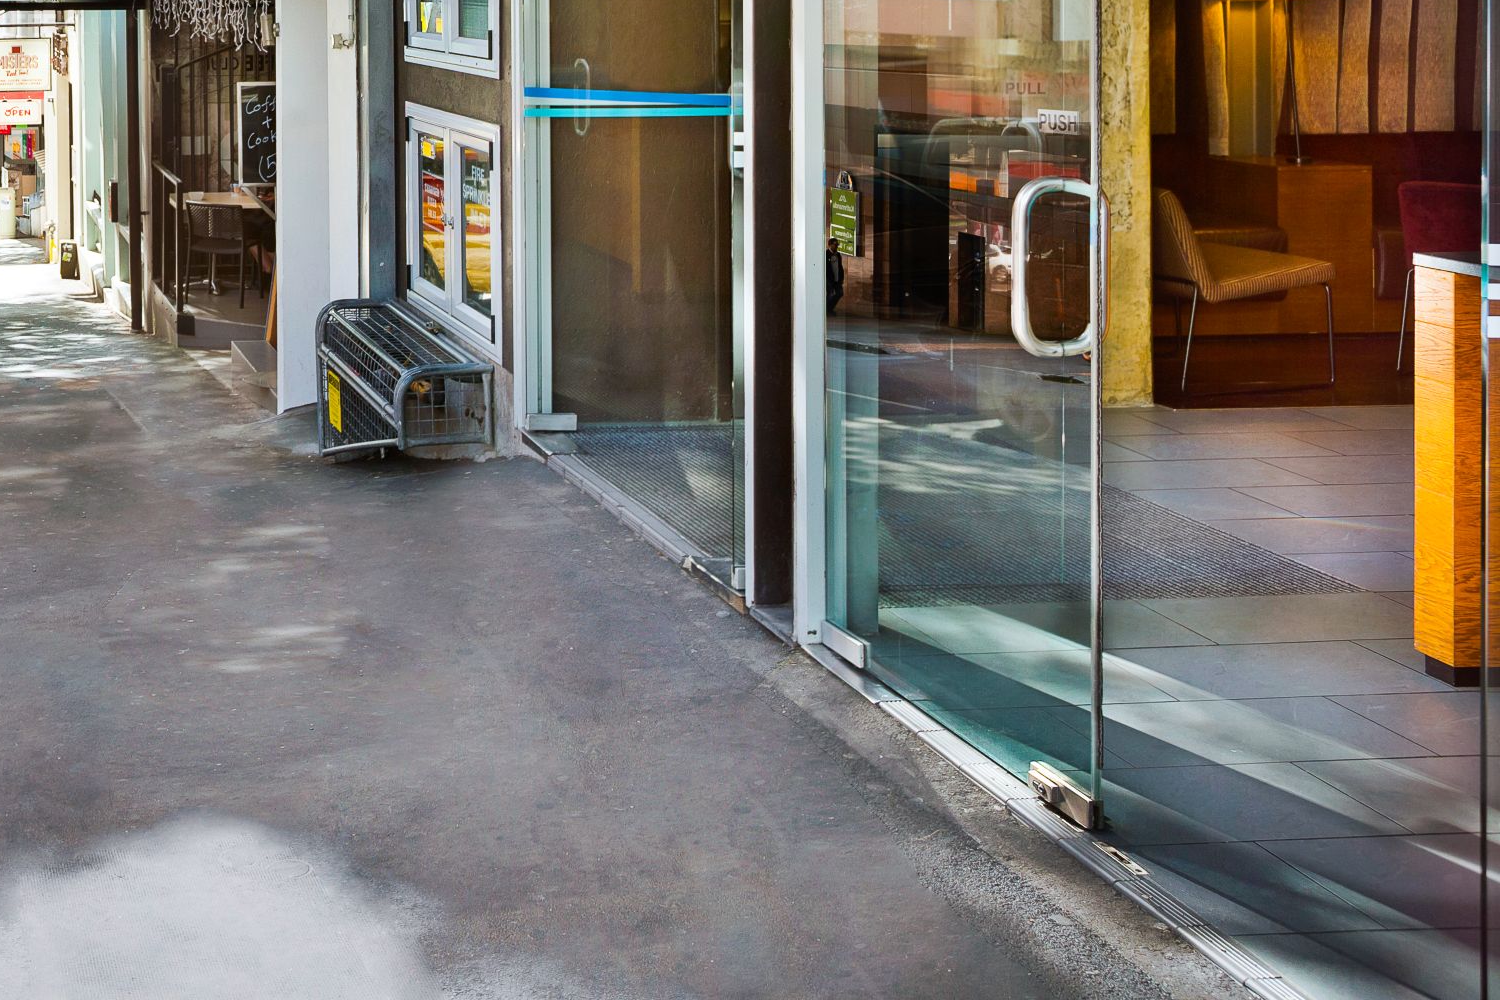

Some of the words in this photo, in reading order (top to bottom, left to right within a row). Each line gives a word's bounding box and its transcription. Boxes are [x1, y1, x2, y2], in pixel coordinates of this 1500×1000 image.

[1005, 82, 1047, 95] PULL
[4, 107, 31, 117] OPEN
[1038, 113, 1077, 132] PUSH
[471, 165, 485, 181] FIRE
